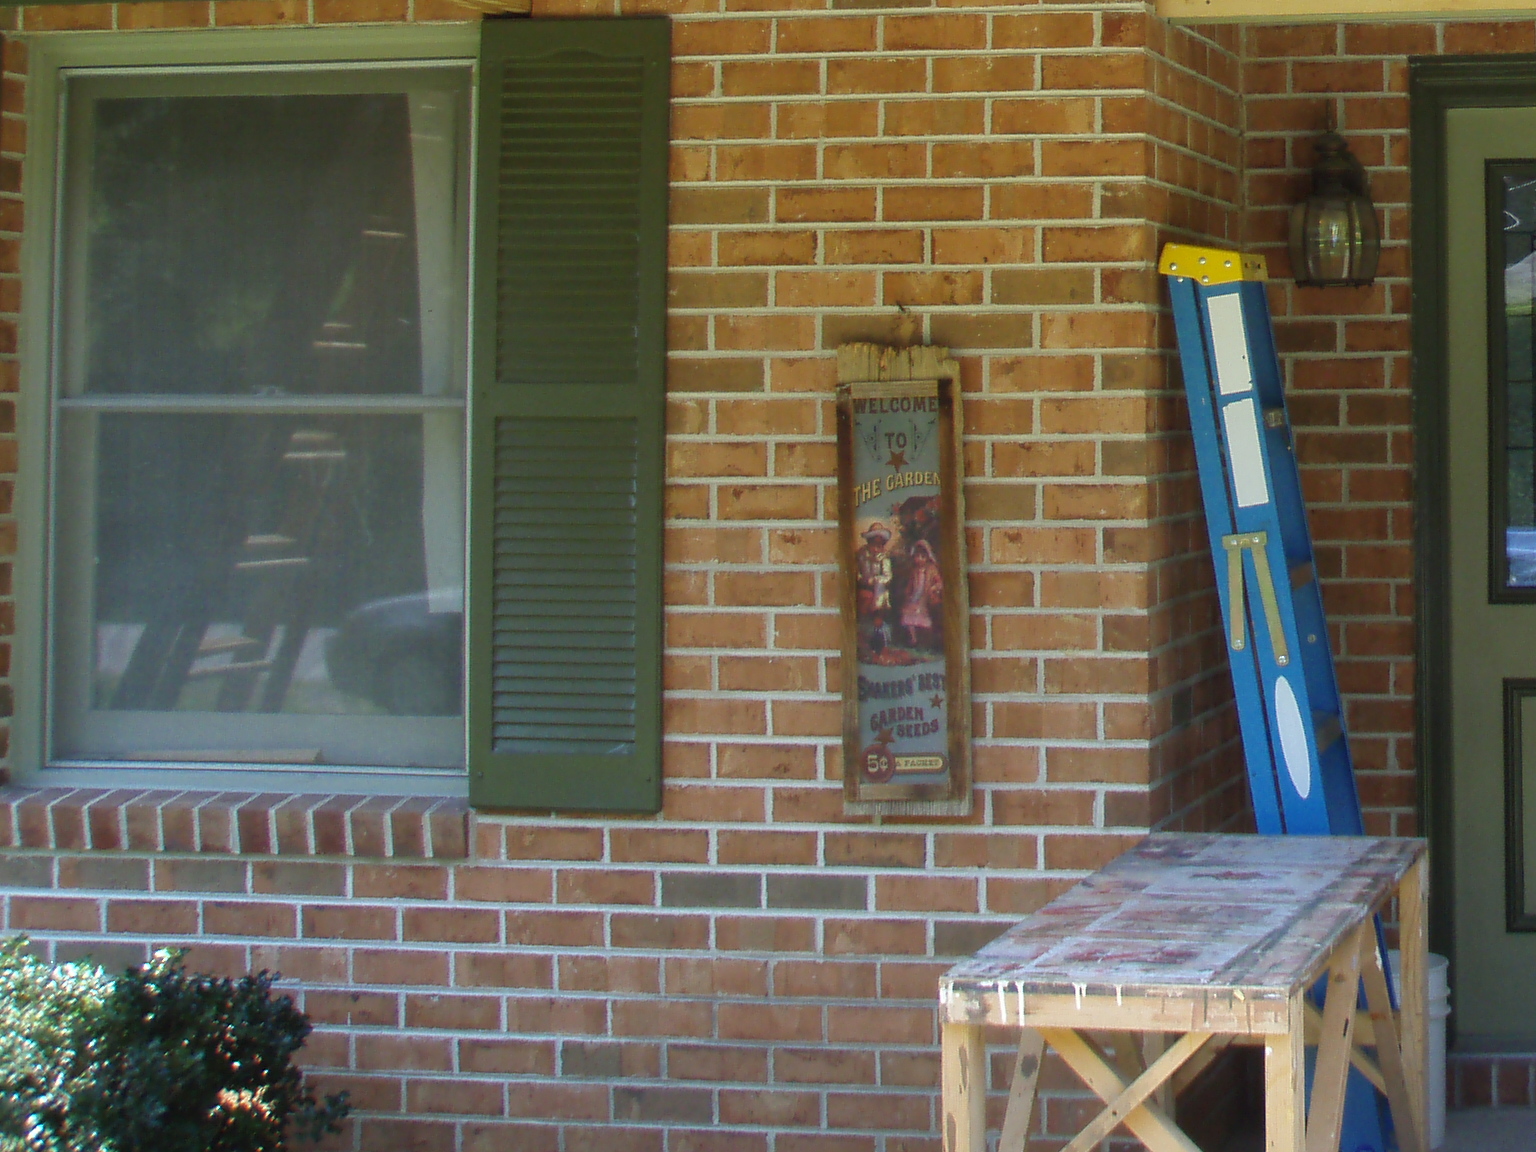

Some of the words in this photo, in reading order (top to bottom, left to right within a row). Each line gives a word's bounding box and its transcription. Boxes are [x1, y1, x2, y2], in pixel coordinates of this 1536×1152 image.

[853, 397, 938, 414] WELCOME
[885, 432, 907, 449] TO
[854, 478, 882, 507] THE
[886, 472, 941, 491] GARDEN
[870, 706, 923, 732] GARDEN
[896, 718, 939, 738] SEEDS
